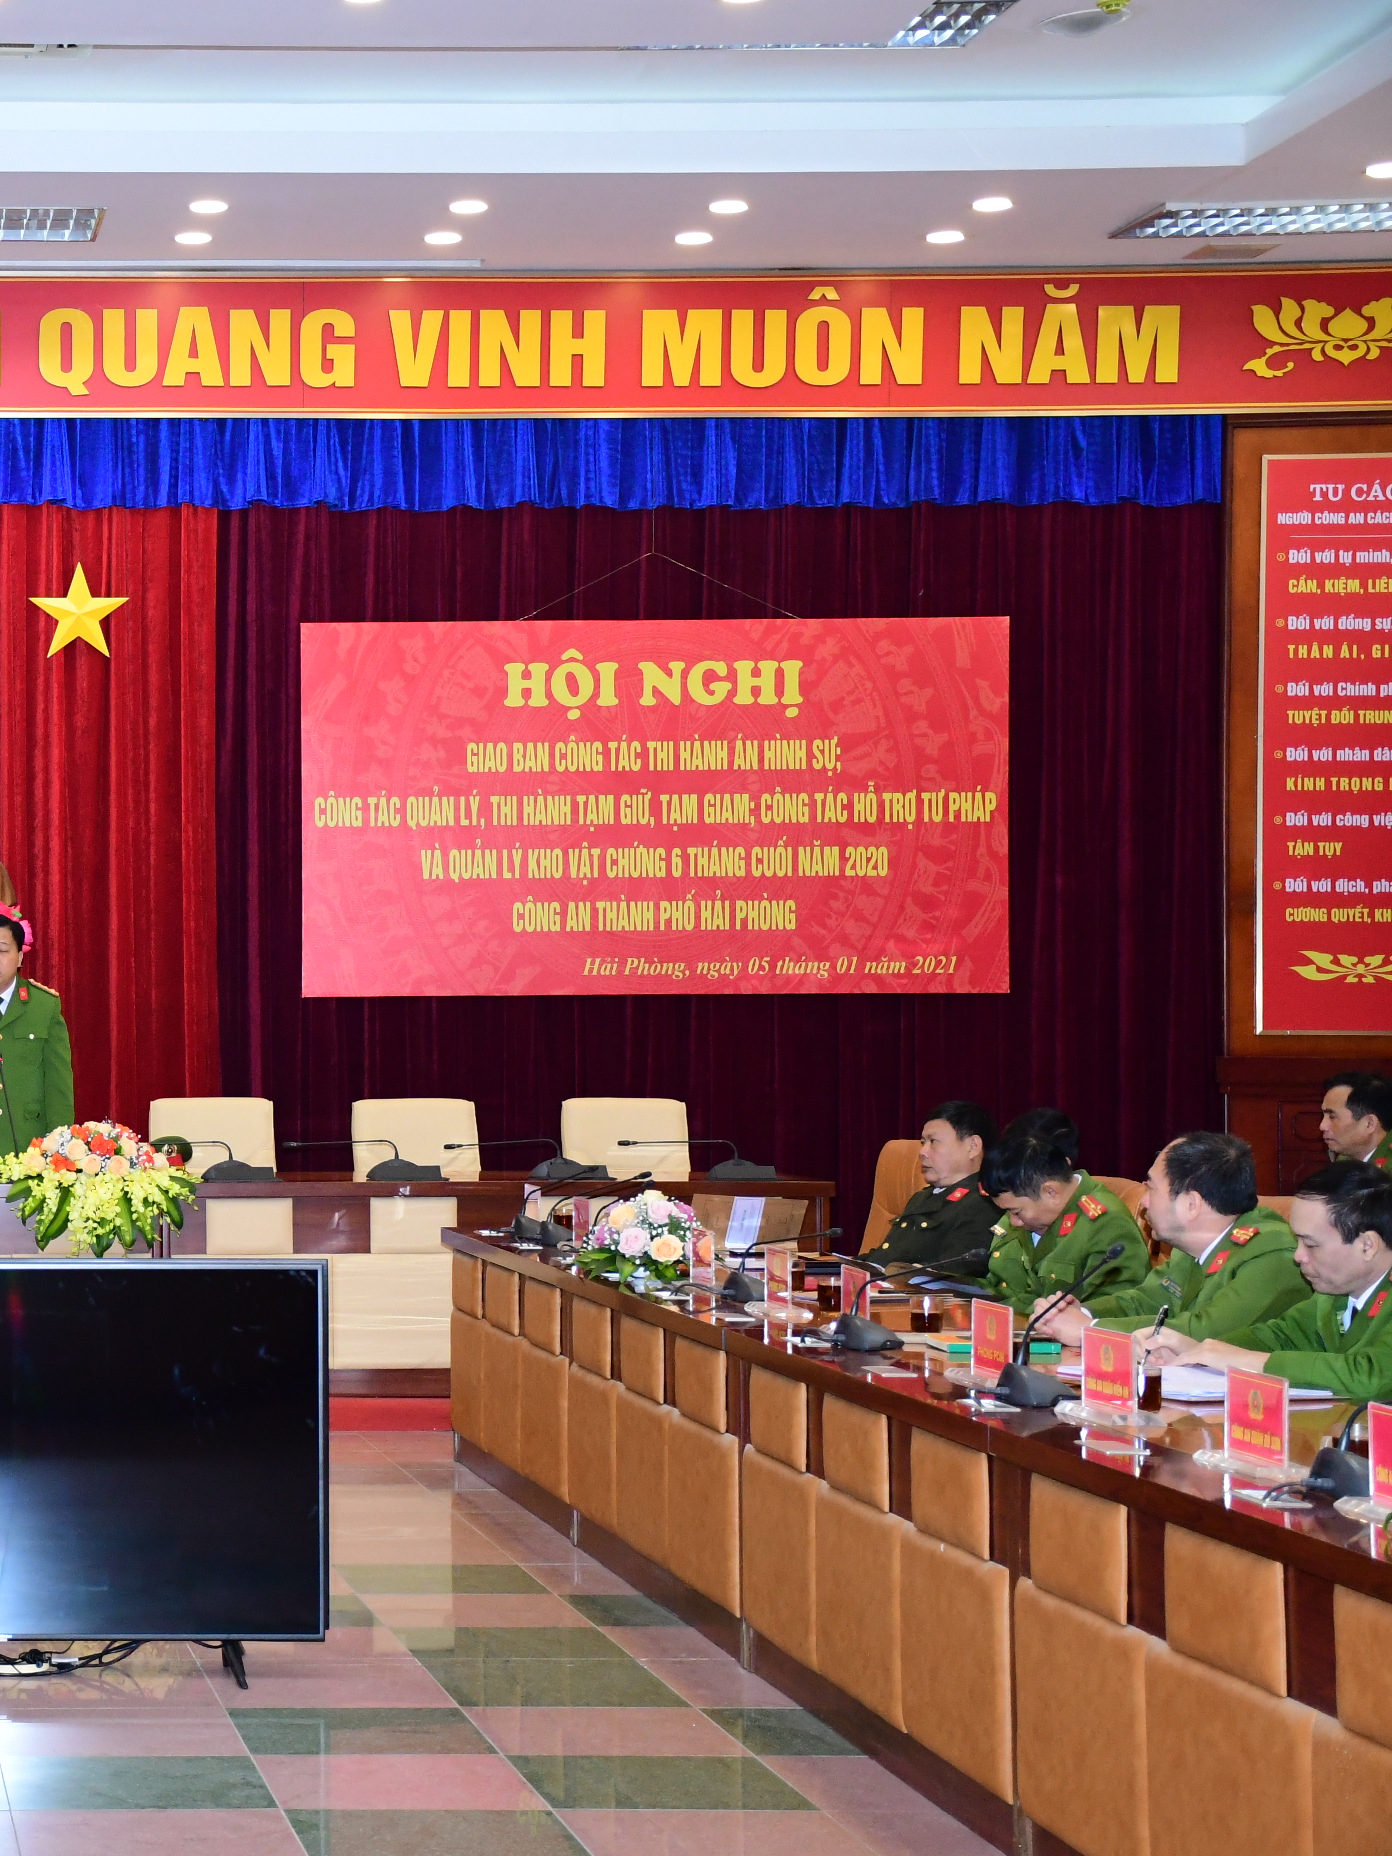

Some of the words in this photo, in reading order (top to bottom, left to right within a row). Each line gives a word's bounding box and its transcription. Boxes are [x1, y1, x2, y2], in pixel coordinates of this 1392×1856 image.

[39, 306, 356, 396] QUANG
[389, 309, 607, 388] VINH
[641, 286, 925, 388] MUÔN
[958, 284, 1181, 386] NĂM
[1309, 484, 1346, 502] TƯ
[1277, 510, 1312, 525] NGƯỜI
[1314, 510, 1346, 525] CÔNG
[1348, 512, 1365, 525] AN
[1288, 547, 1311, 564] Đối
[1314, 548, 1336, 564] với
[1338, 549, 1353, 567] tự
[1288, 574, 1321, 595] CẦN,
[1324, 576, 1364, 596] KIỆM,
[1287, 613, 1310, 630] Đối
[1313, 615, 1334, 630] với
[1337, 613, 1372, 632] đồng
[1287, 641, 1334, 659] THÂN
[1340, 641, 1365, 660] ÁI,
[504, 648, 620, 720] HỘI
[638, 659, 805, 719] NGHỊ
[1286, 680, 1310, 697] Đối
[1313, 681, 1334, 697] với
[1337, 681, 1377, 697] Chính
[1286, 707, 1328, 727] TUYỆT
[1331, 705, 1355, 724] ĐỐI
[467, 742, 508, 772] GIAO
[513, 742, 550, 772] BAN
[555, 736, 604, 772] CÔNG
[608, 735, 642, 771] TÁC
[647, 741, 675, 771] THI
[680, 734, 729, 771] HÀNH
[734, 734, 759, 770] ÁN
[764, 734, 808, 770] HÌNH
[812, 736, 842, 776] SỰ;
[1285, 745, 1309, 762] Đối
[1312, 746, 1333, 762] với
[1336, 746, 1370, 762] nhân
[1373, 746, 1392, 761] dâ
[1286, 774, 1325, 791] KÍNH
[1330, 777, 1384, 794] TRỌNG
[315, 791, 363, 827] CÔNG
[368, 791, 401, 827] TÁC
[407, 786, 455, 829] QUẢN
[460, 790, 486, 829] LÝ,
[491, 796, 518, 825] THI
[524, 789, 572, 825] HÀNH
[577, 794, 615, 831] TẠM
[620, 788, 656, 828] GIỮ,
[660, 794, 698, 831] TẠM
[704, 793, 756, 827] GIAM;
[761, 787, 810, 824] CÔNG
[814, 786, 848, 824] TÁC
[853, 781, 878, 823] HỖ
[882, 789, 917, 830] TRỢ
[921, 789, 946, 823] TƯ
[949, 786, 998, 823] PHÁP
[1285, 810, 1308, 826] Đối
[1311, 811, 1332, 826] với
[1335, 812, 1370, 828] công
[1287, 839, 1314, 859] TẬN
[1317, 841, 1343, 859] TỤY
[421, 843, 444, 880] VÀ
[449, 838, 498, 883] QUẢN
[503, 843, 523, 879] LÝ
[528, 848, 564, 879] KHO
[569, 842, 601, 885] VẬT
[606, 842, 667, 878] CHỨNG
[671, 847, 683, 878] 6
[687, 842, 747, 877] THÁNG
[751, 835, 793, 877] CUỐI
[798, 840, 840, 877] NĂM
[845, 846, 889, 877] 2020
[1284, 876, 1308, 893] Đối
[1311, 878, 1332, 893] với
[1335, 878, 1369, 896] địch,
[513, 896, 561, 932] CÔNG
[566, 902, 592, 931] AN
[596, 896, 655, 931] THÀNH
[660, 890, 696, 931] PHỐ
[701, 890, 731, 930] HẢI
[735, 893, 797, 930] PHÒNG
[1285, 906, 1328, 922] CƯƠNG
[1330, 904, 1371, 924] QUYẾT,
[583, 957, 619, 976] Hải
[624, 957, 690, 980] Phòng,
[697, 957, 742, 980] ngày
[748, 957, 771, 975] 05
[776, 956, 830, 978] tháng
[836, 957, 858, 974] 01
[865, 957, 907, 975] năm
[912, 955, 958, 974] 2021
